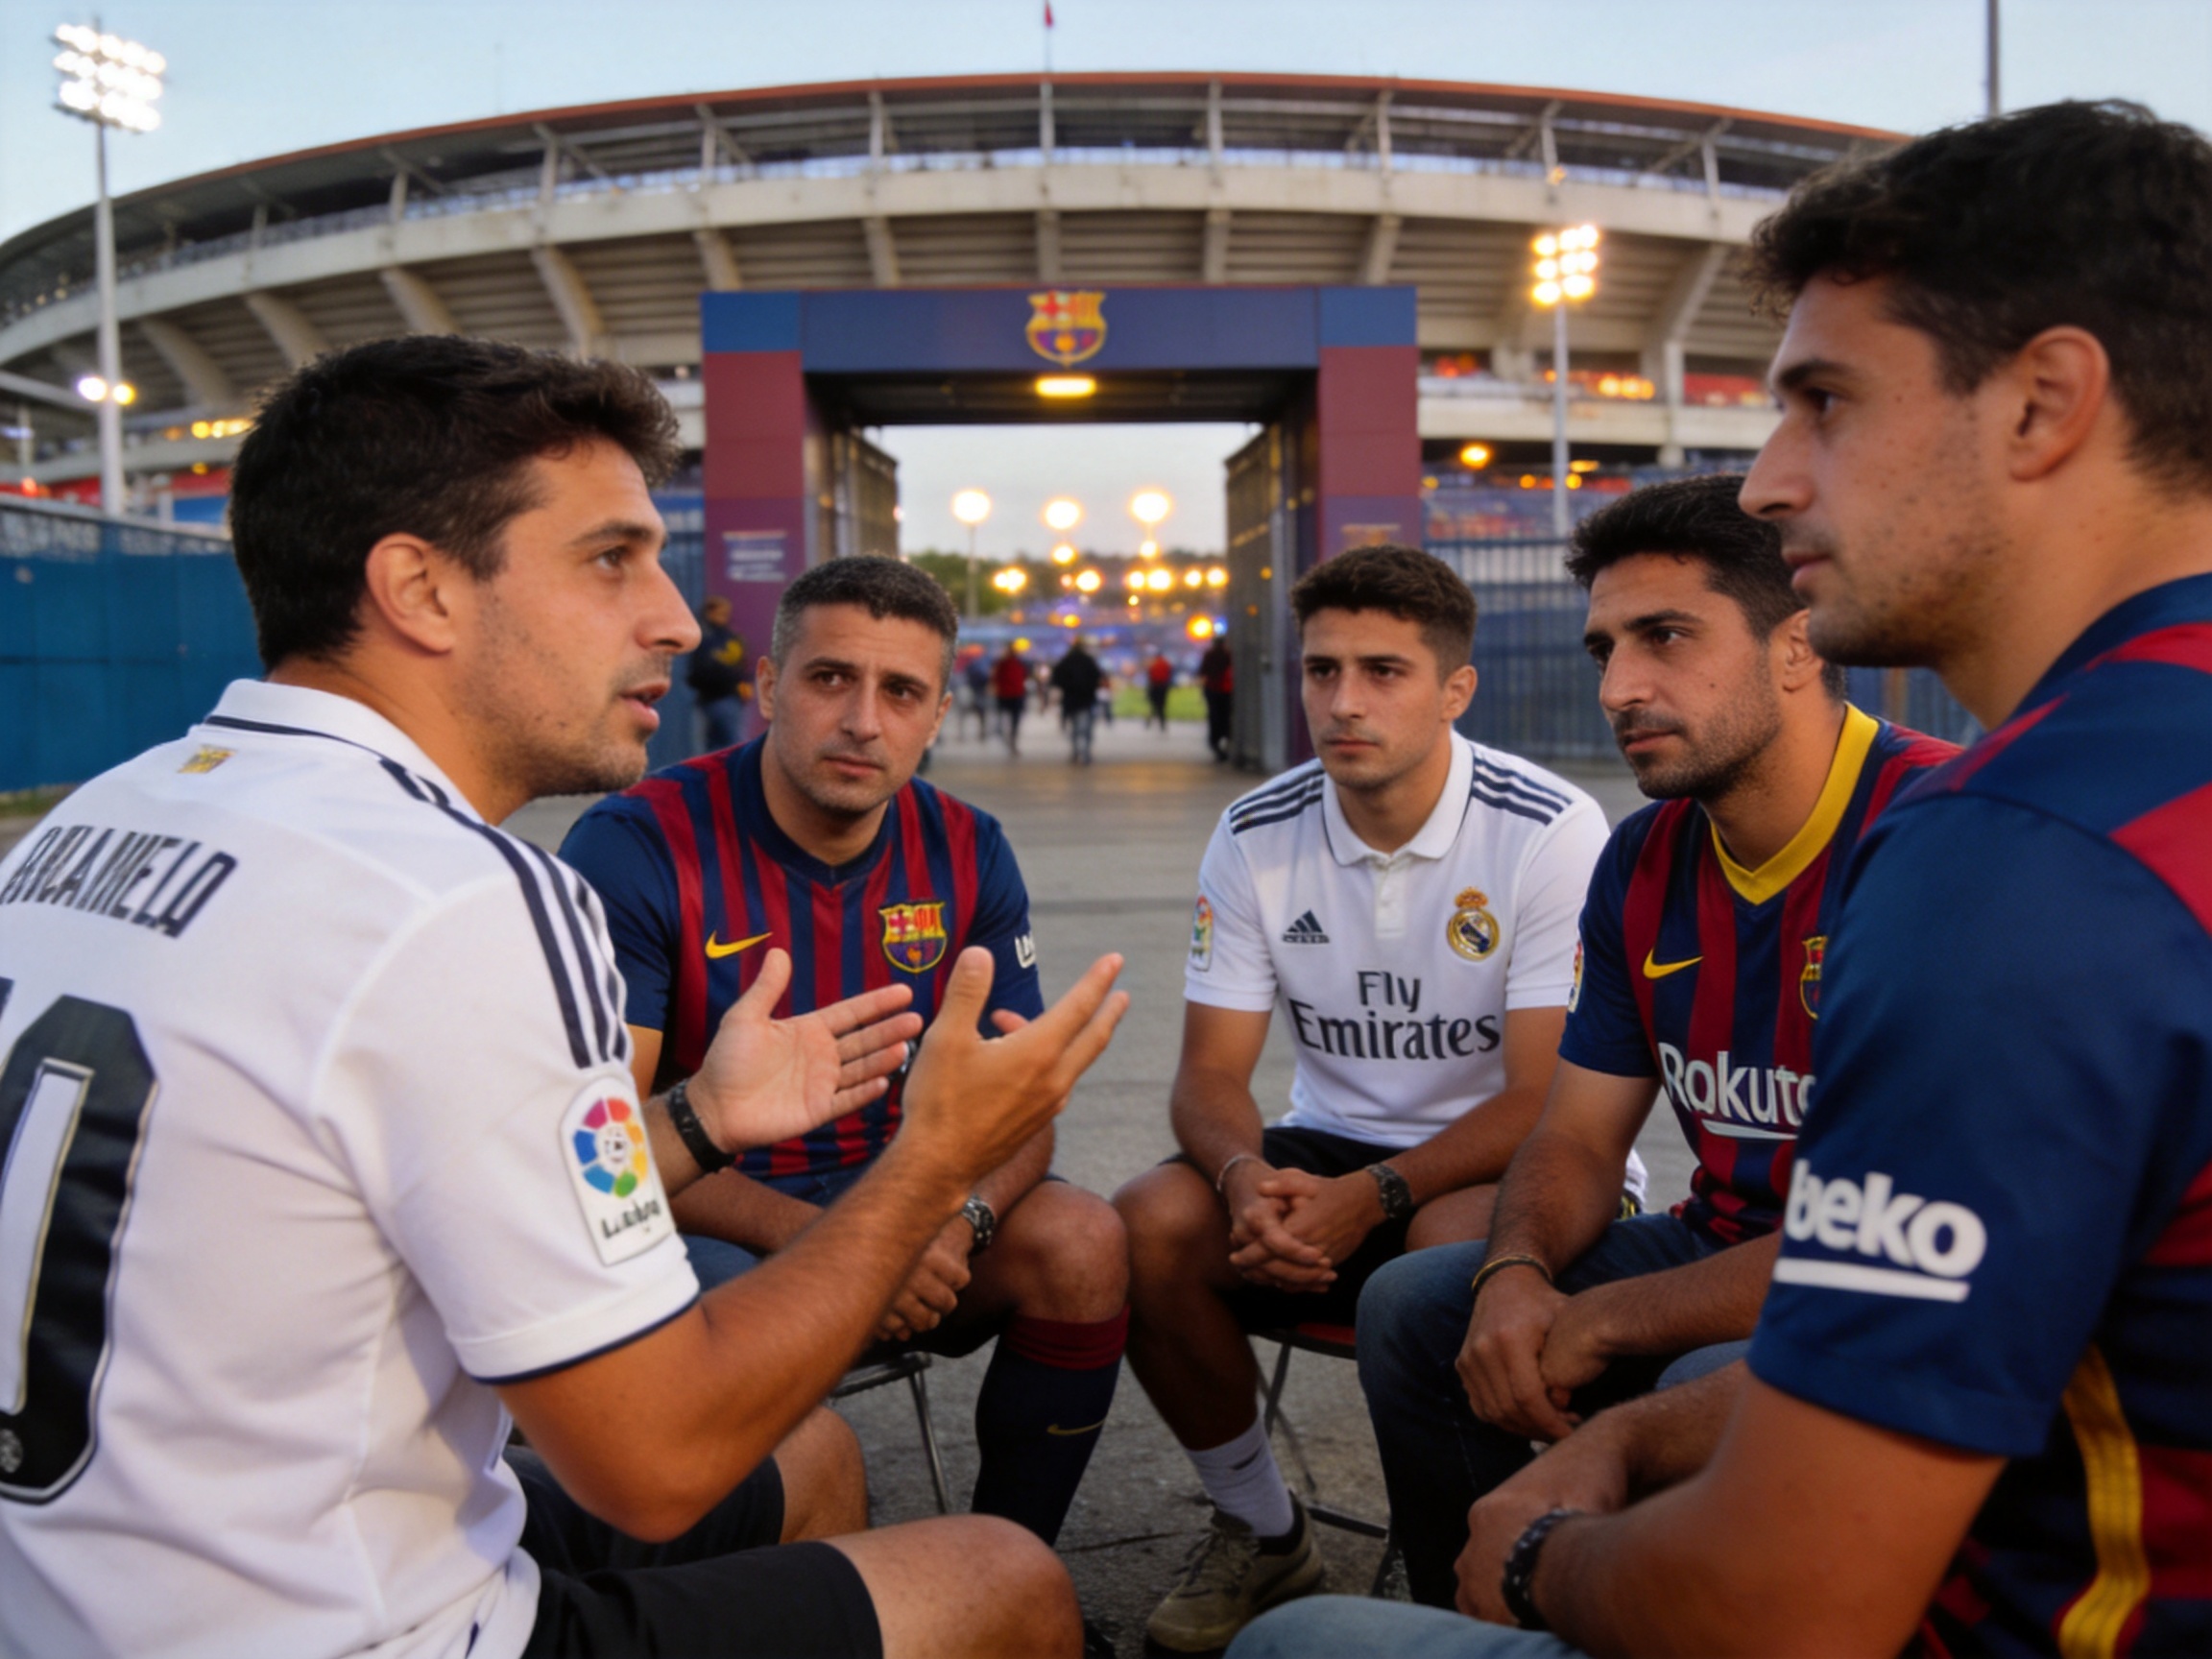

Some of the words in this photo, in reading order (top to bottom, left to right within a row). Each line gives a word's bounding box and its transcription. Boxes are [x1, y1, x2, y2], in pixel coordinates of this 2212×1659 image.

[1357, 971, 1421, 1013] Fly
[1289, 999, 1501, 1060] Emirates
[1784, 1158, 1987, 1278] beko
